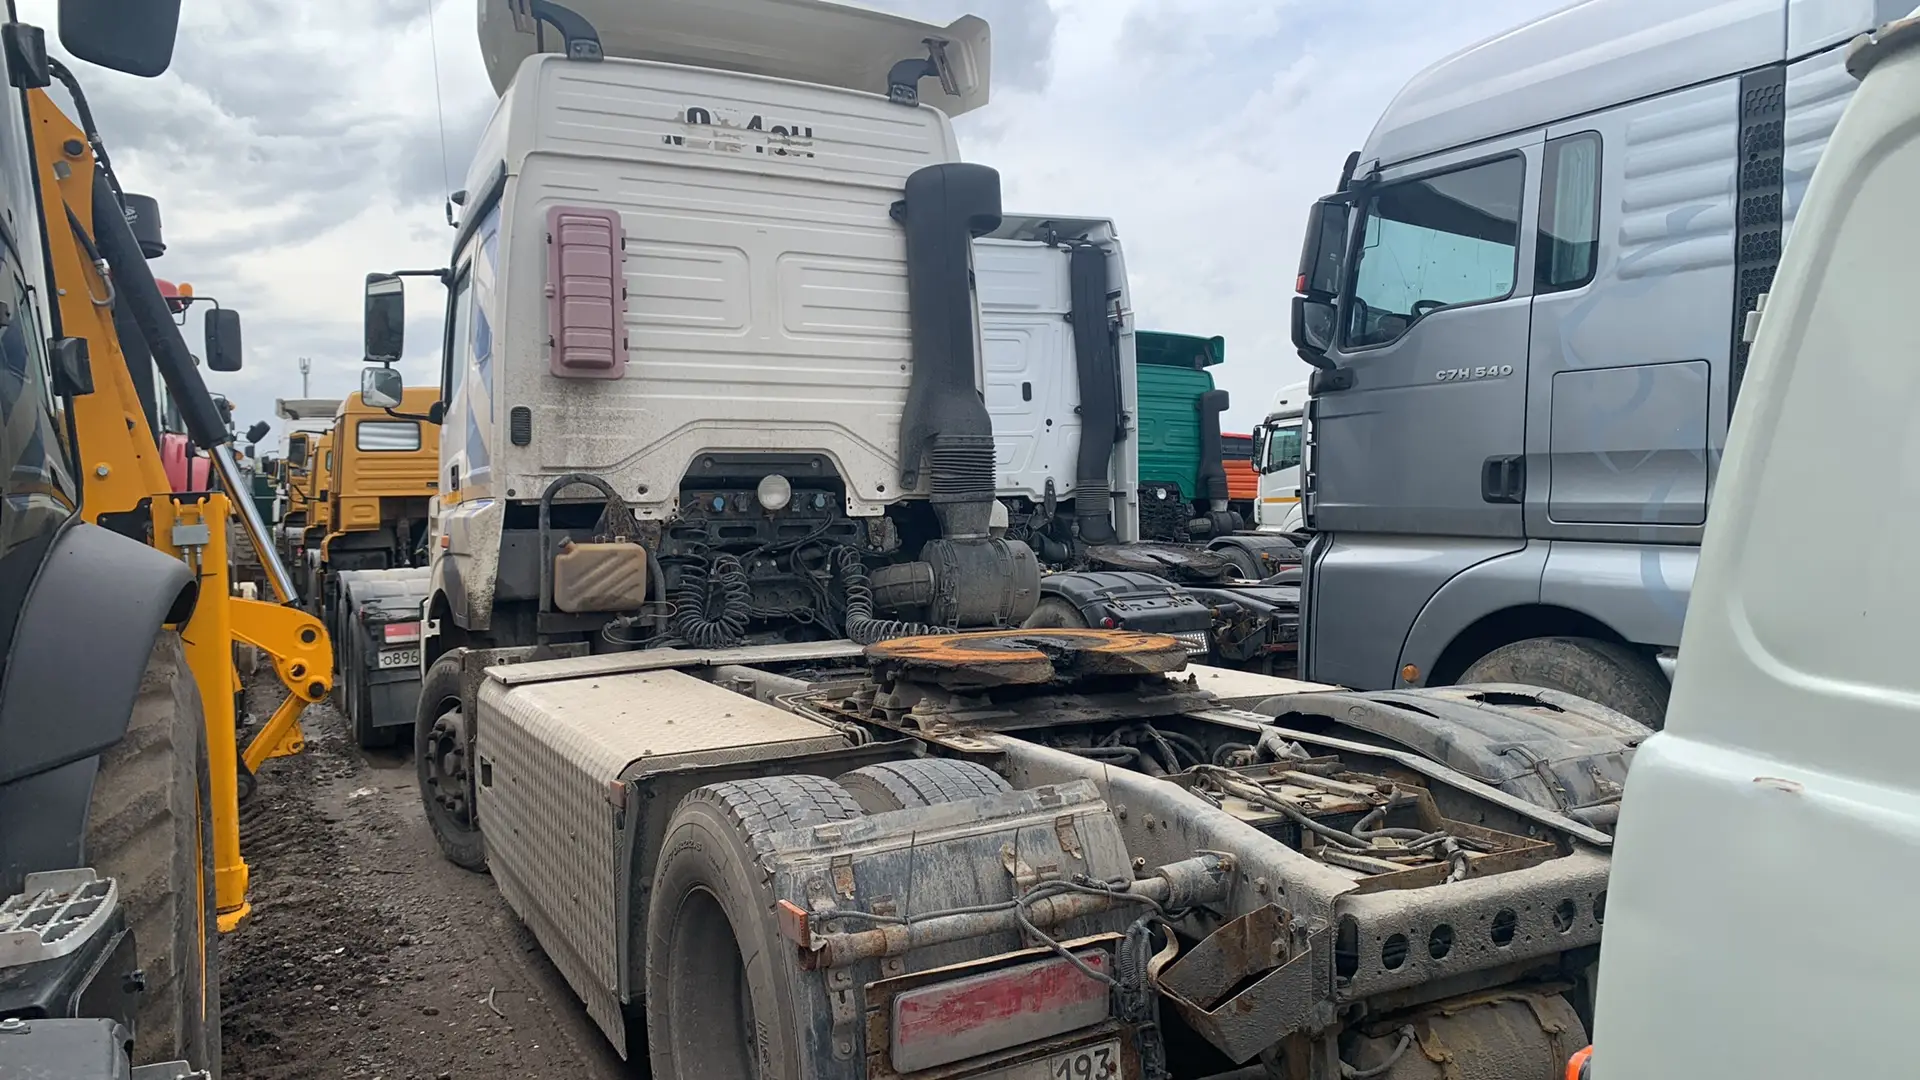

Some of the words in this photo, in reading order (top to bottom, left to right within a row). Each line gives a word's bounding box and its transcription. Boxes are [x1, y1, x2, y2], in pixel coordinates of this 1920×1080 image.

[1436, 368, 1470, 381] C7H
[1475, 364, 1513, 378] 540
[1056, 1047, 1110, 1080] 193
